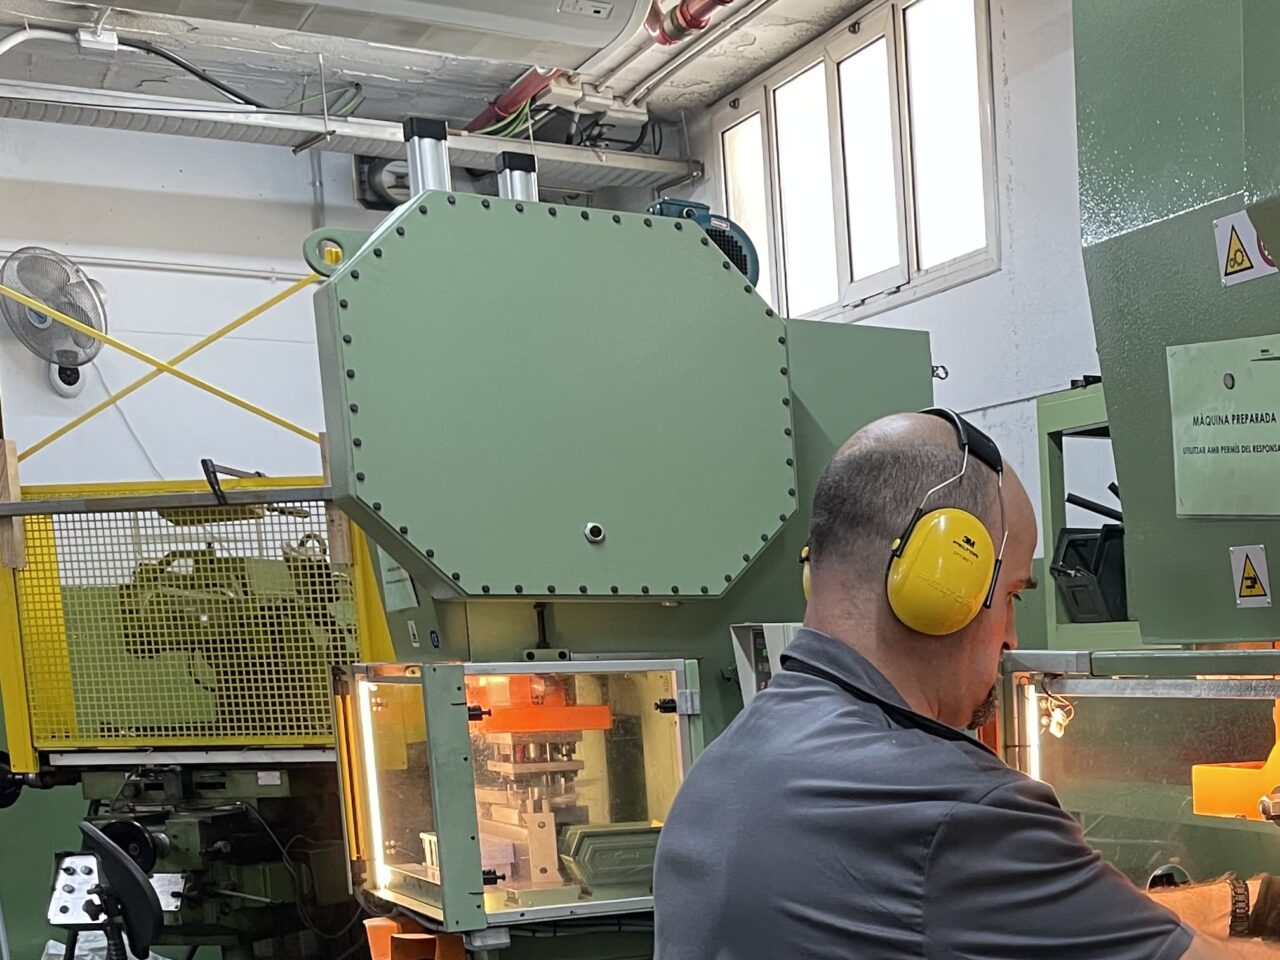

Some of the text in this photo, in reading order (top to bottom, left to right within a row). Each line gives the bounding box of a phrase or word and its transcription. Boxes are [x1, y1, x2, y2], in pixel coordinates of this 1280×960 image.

[1232, 412, 1277, 425] PREPARADA
[1207, 446, 1219, 454] AMB
[1241, 445, 1251, 453] DEL
